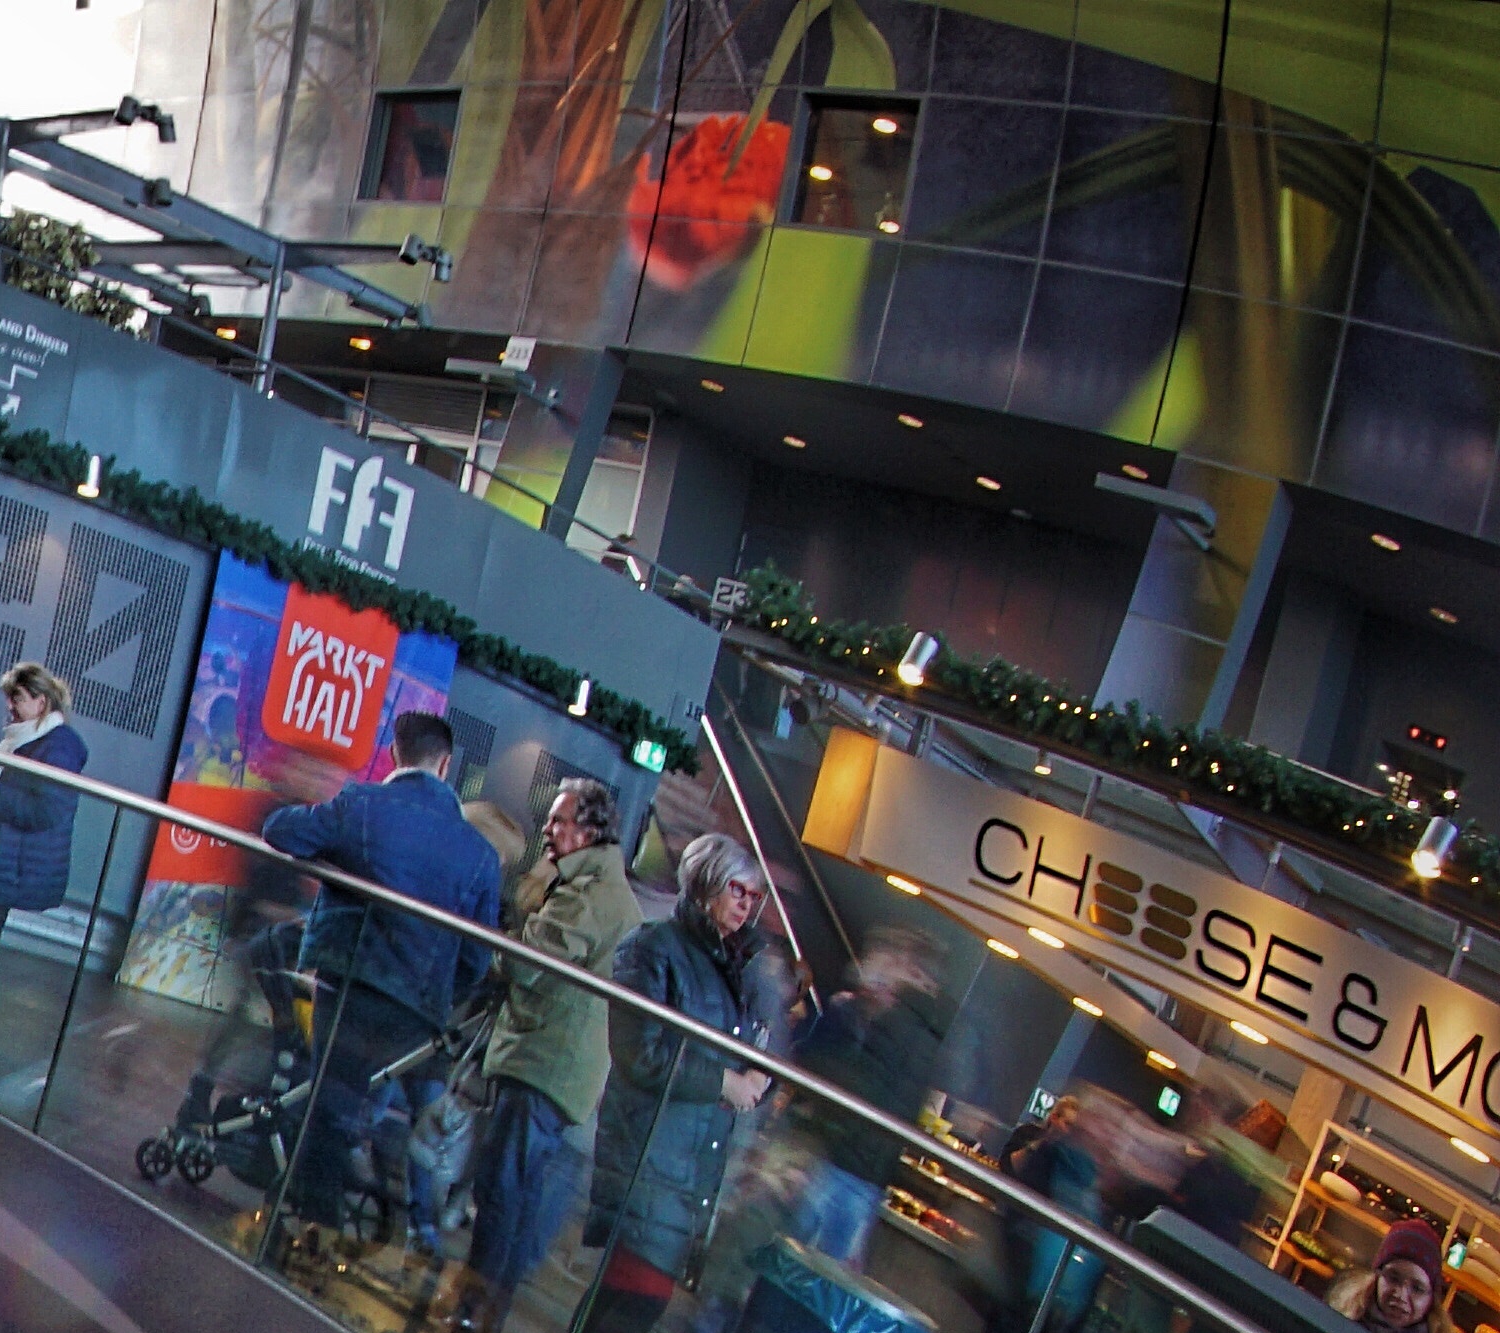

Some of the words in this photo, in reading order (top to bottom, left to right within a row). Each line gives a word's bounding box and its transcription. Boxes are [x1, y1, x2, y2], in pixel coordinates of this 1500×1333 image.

[287, 620, 386, 690] MARKT
[282, 665, 364, 750] HAL
[974, 817, 1323, 1022] CHEESE
[1332, 972, 1390, 1053] &
[1401, 1004, 1500, 1124] M
